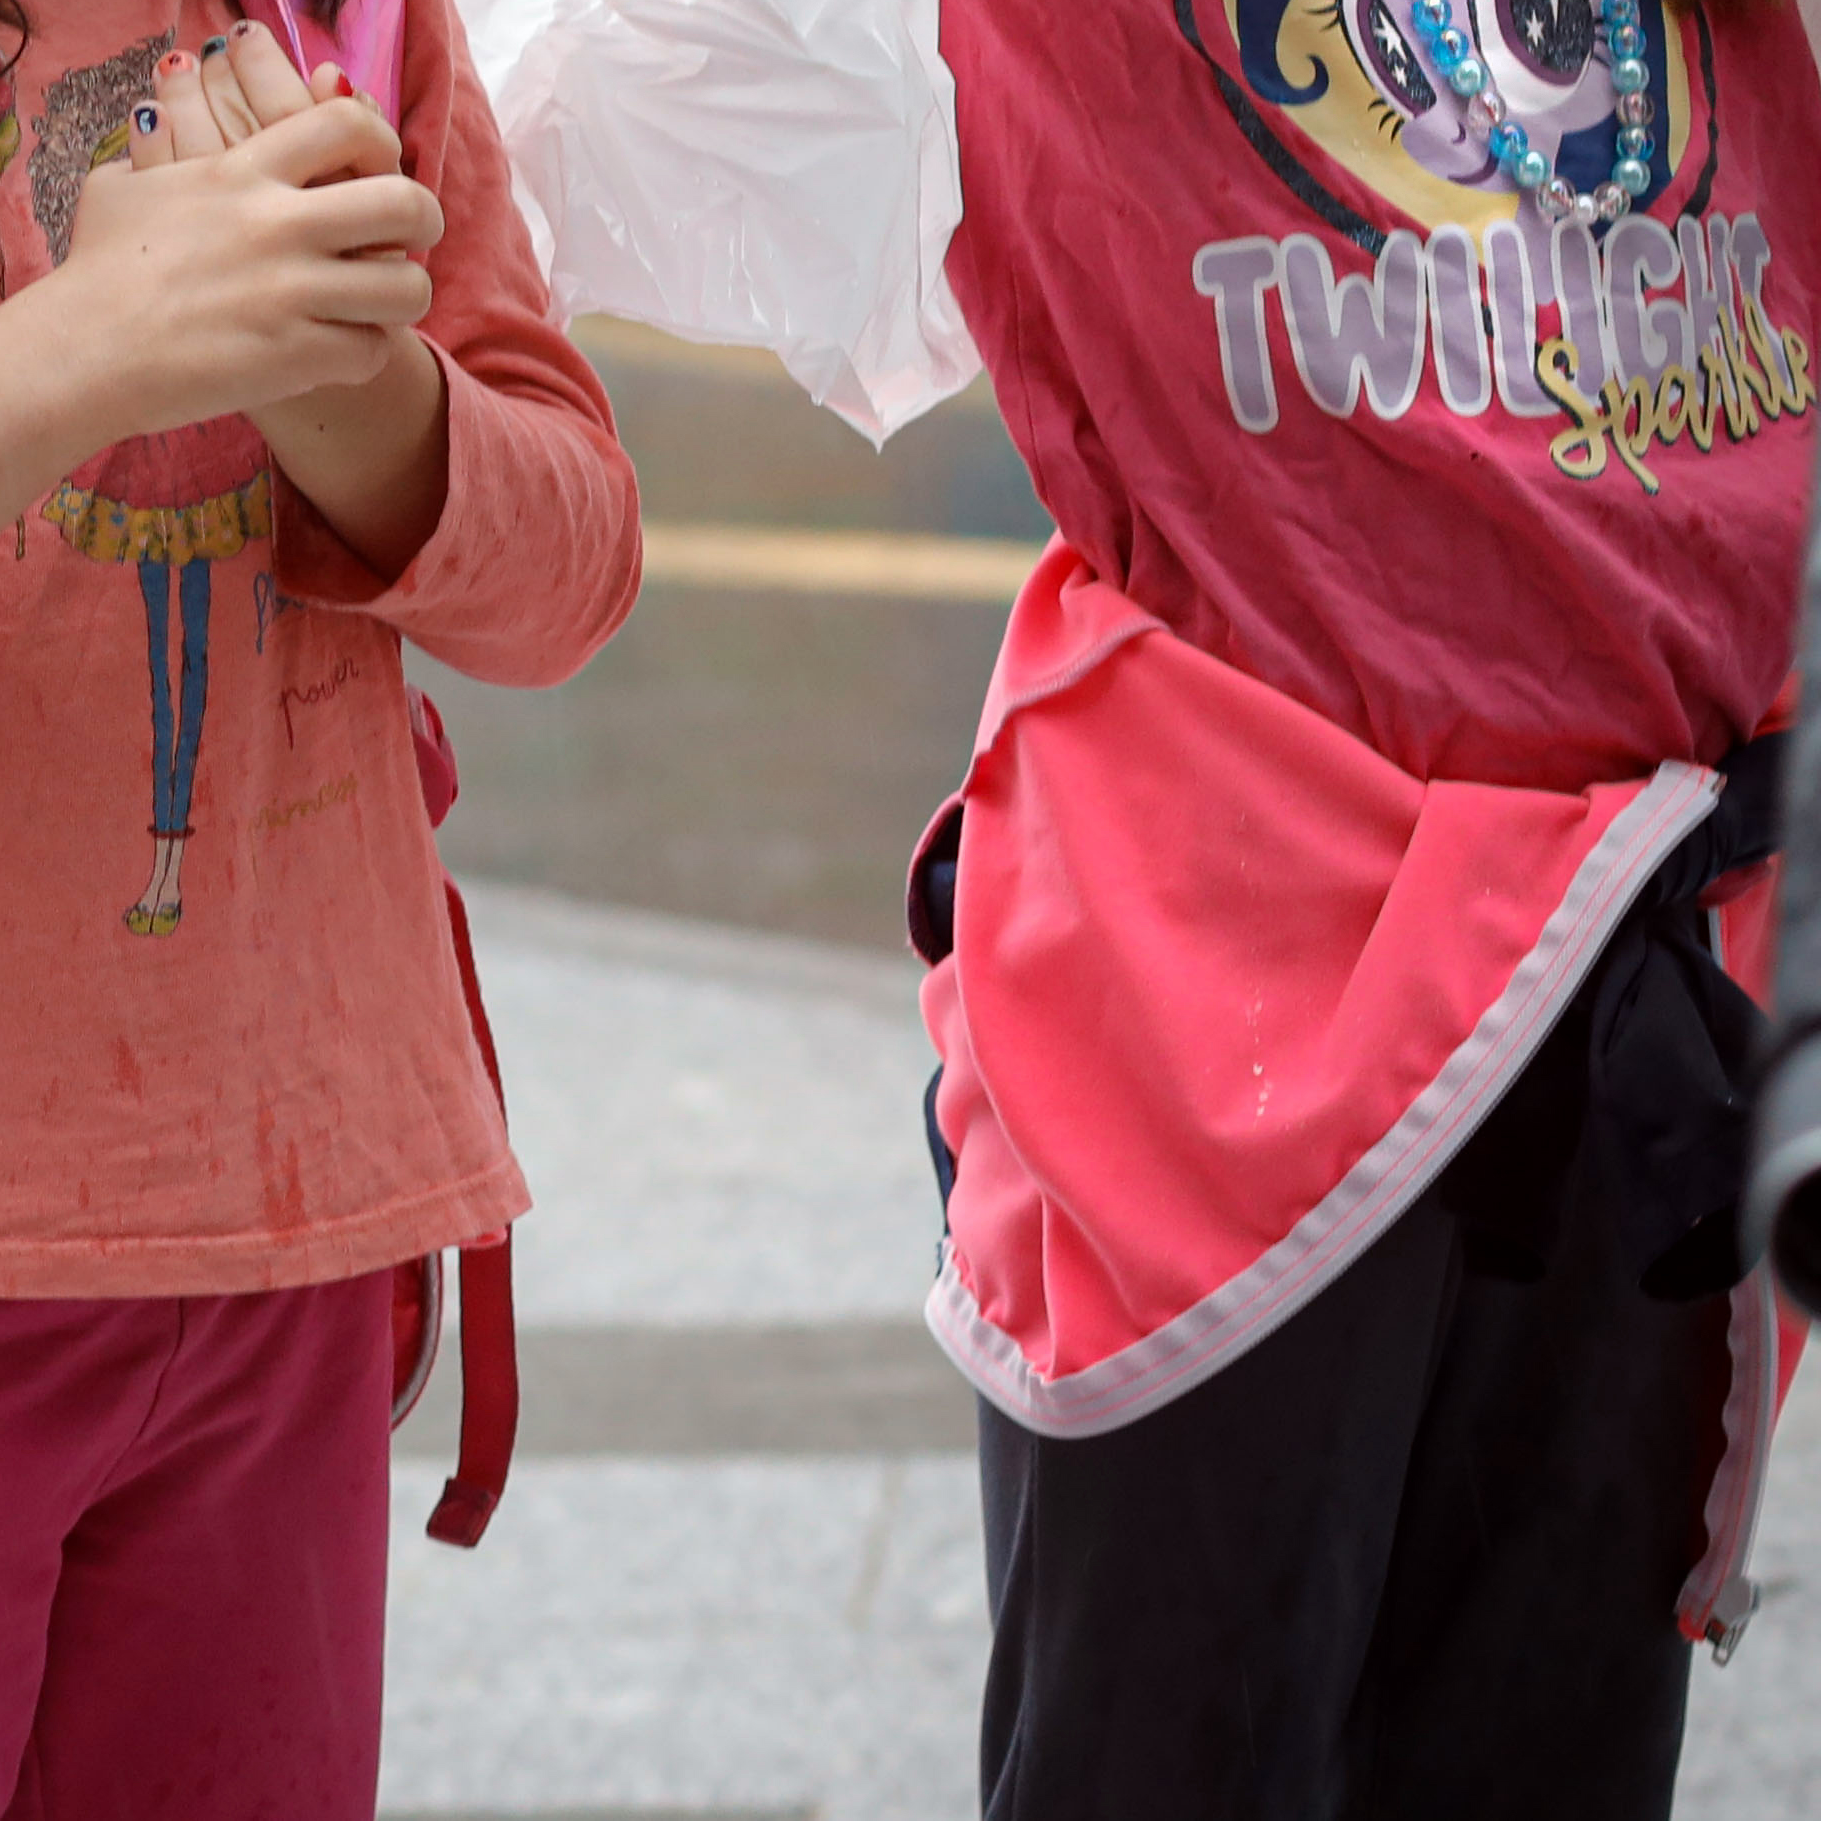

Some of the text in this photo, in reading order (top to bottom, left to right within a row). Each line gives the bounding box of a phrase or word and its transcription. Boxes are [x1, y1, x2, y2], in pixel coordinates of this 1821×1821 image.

[1192, 211, 1794, 434] TWILIGHT
[1533, 291, 1818, 495] Sparkle
[279, 657, 359, 751] power
